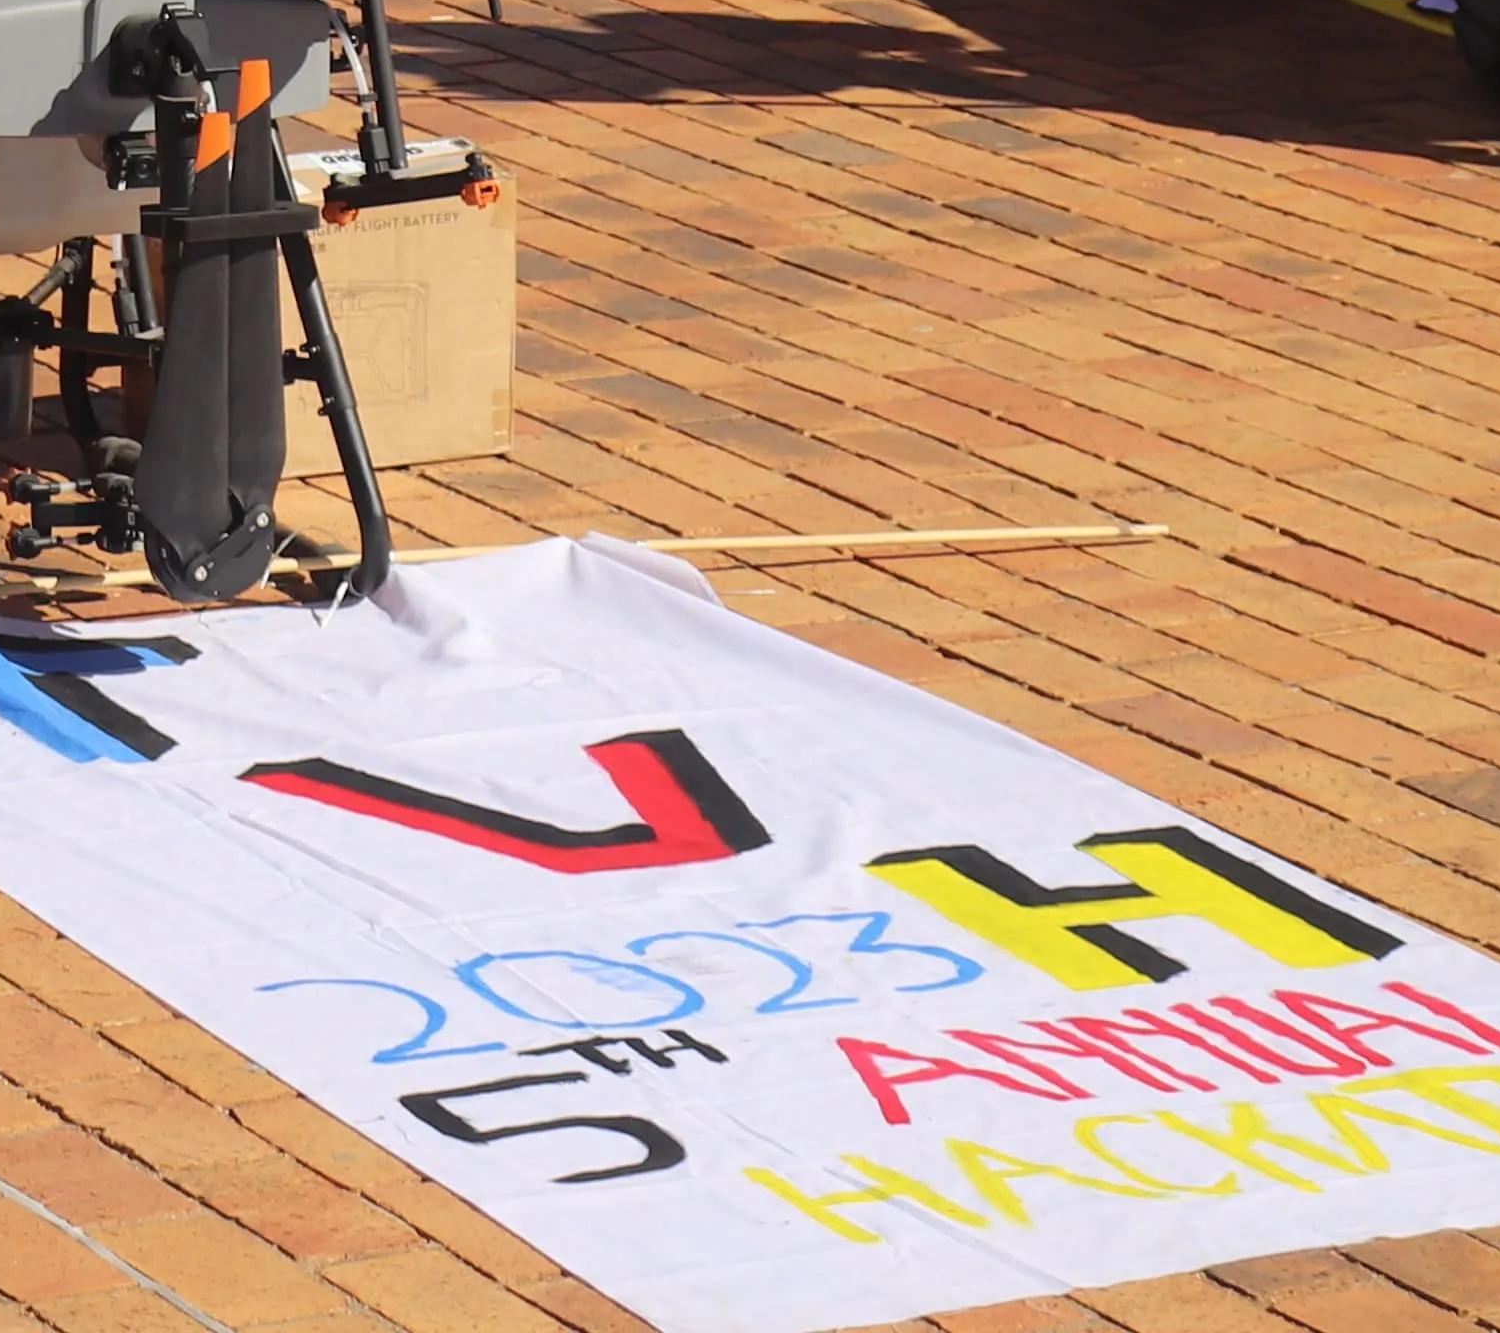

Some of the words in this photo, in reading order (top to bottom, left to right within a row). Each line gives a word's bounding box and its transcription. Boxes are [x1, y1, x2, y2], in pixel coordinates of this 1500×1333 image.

[354, 217, 399, 232] FLIGHT
[403, 212, 461, 229] BATTERY
[254, 908, 986, 1065] 2023
